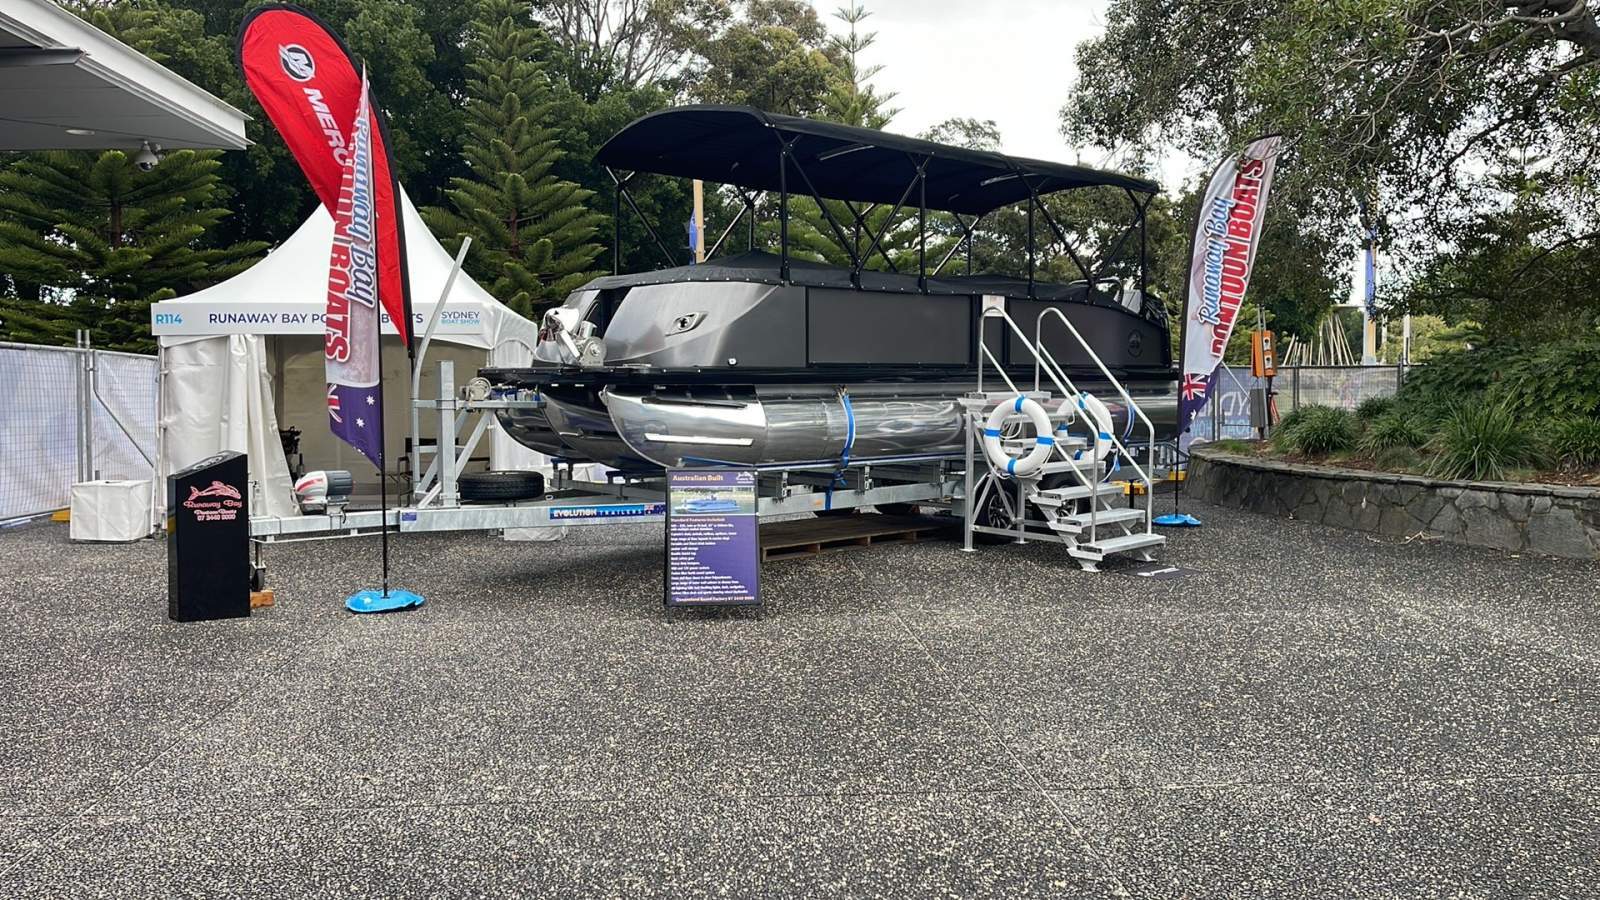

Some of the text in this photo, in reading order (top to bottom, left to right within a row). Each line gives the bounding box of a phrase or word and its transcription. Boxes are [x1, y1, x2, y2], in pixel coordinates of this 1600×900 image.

[303, 88, 349, 167] MERC
[346, 118, 376, 308] Runaway Bay
[1228, 158, 1266, 241] BOATS
[1198, 196, 1235, 325] Runaway Bay
[156, 313, 183, 324] R114
[209, 313, 278, 324] RUNAWAY
[282, 313, 308, 324] BAY
[325, 240, 351, 362] BOATS
[441, 311, 480, 319] SYDNEY
[183, 500, 242, 509] Runaway Bay
[553, 508, 597, 517] EVOLUTION
